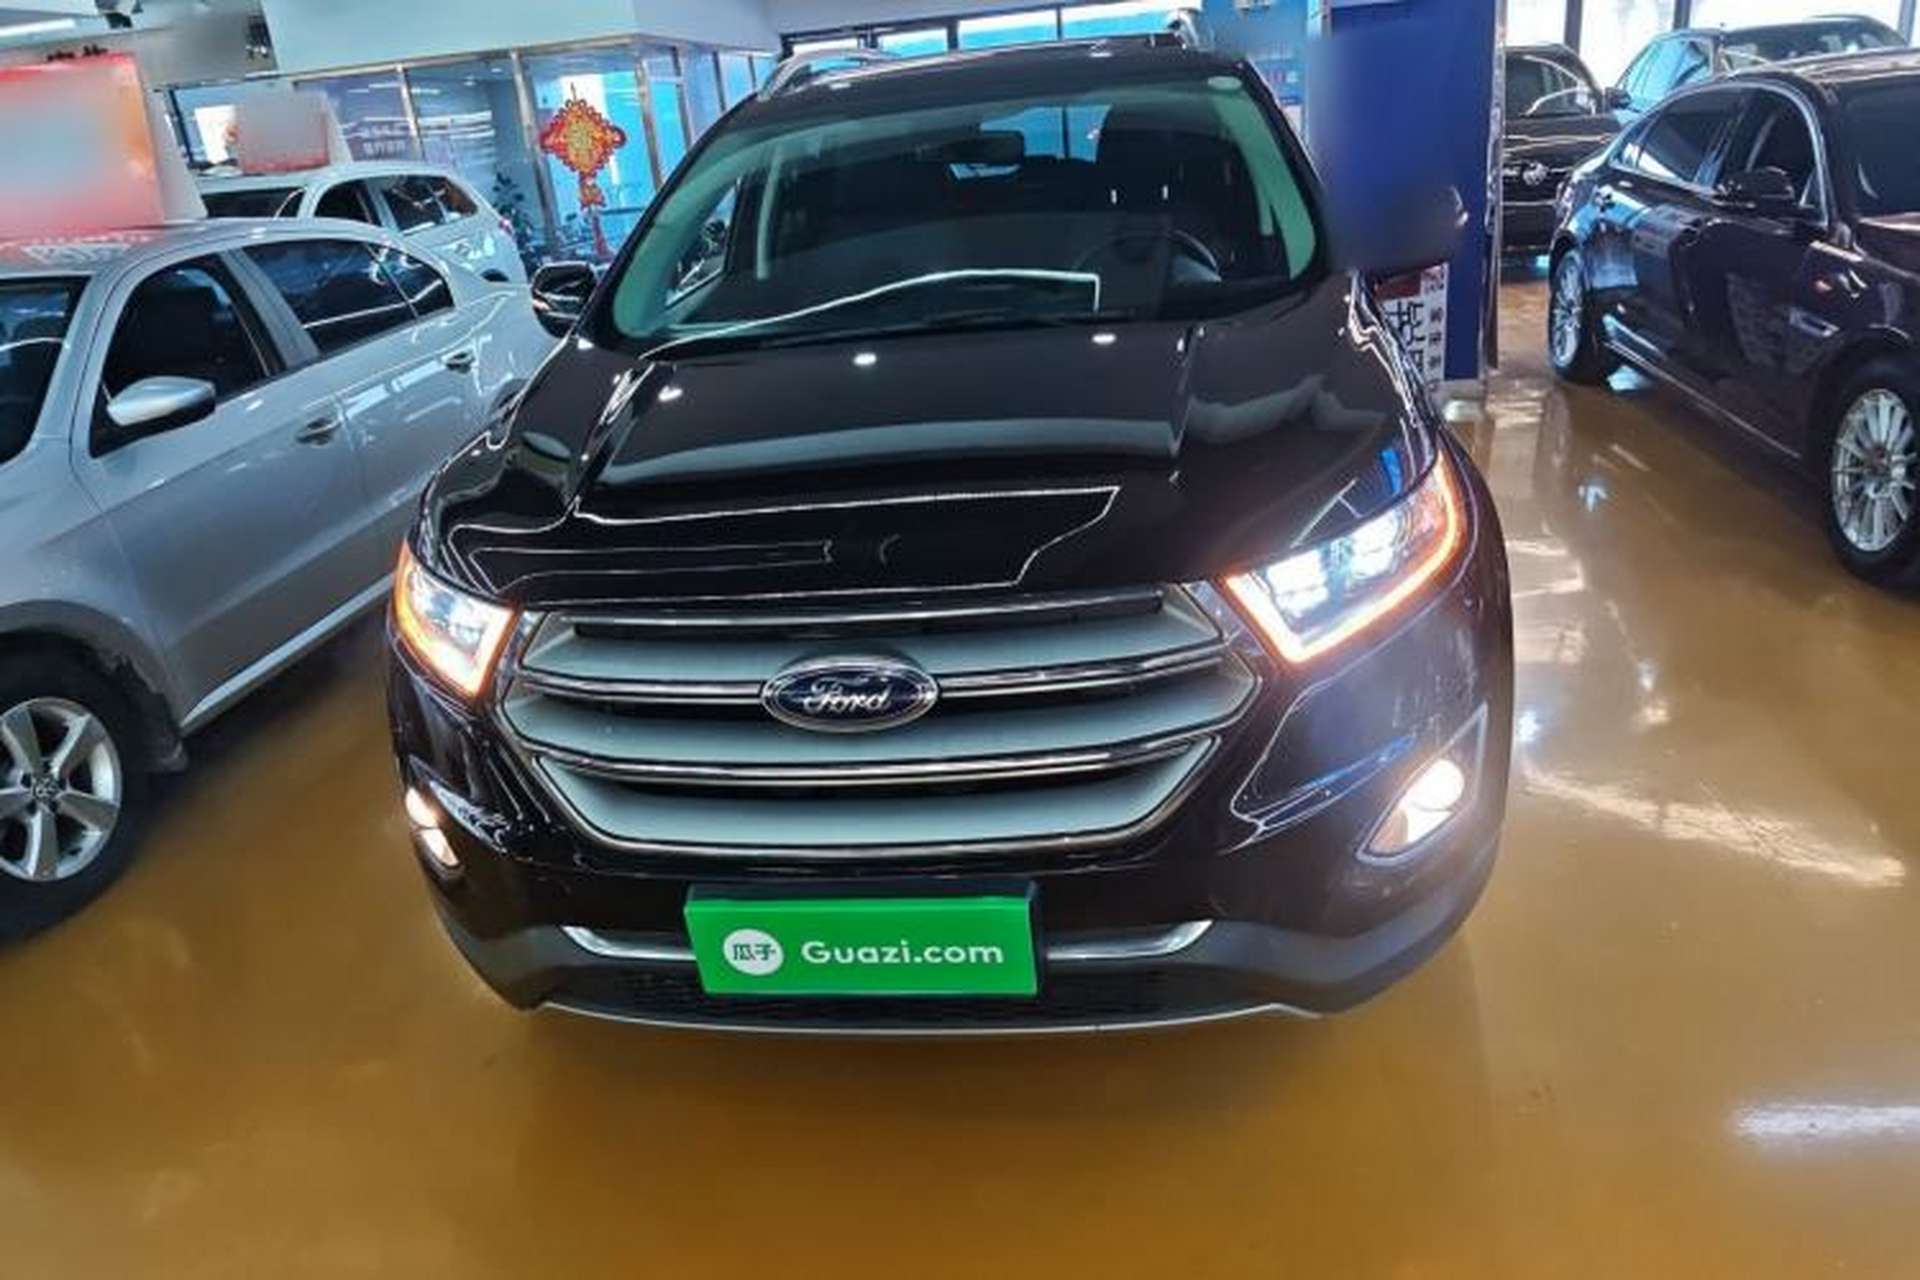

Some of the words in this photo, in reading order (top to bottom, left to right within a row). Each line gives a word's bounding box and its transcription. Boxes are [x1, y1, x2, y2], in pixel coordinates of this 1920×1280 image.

[802, 677, 893, 713] Ford
[732, 943, 776, 961] 瓜子
[800, 939, 1004, 964] Guazi.com
